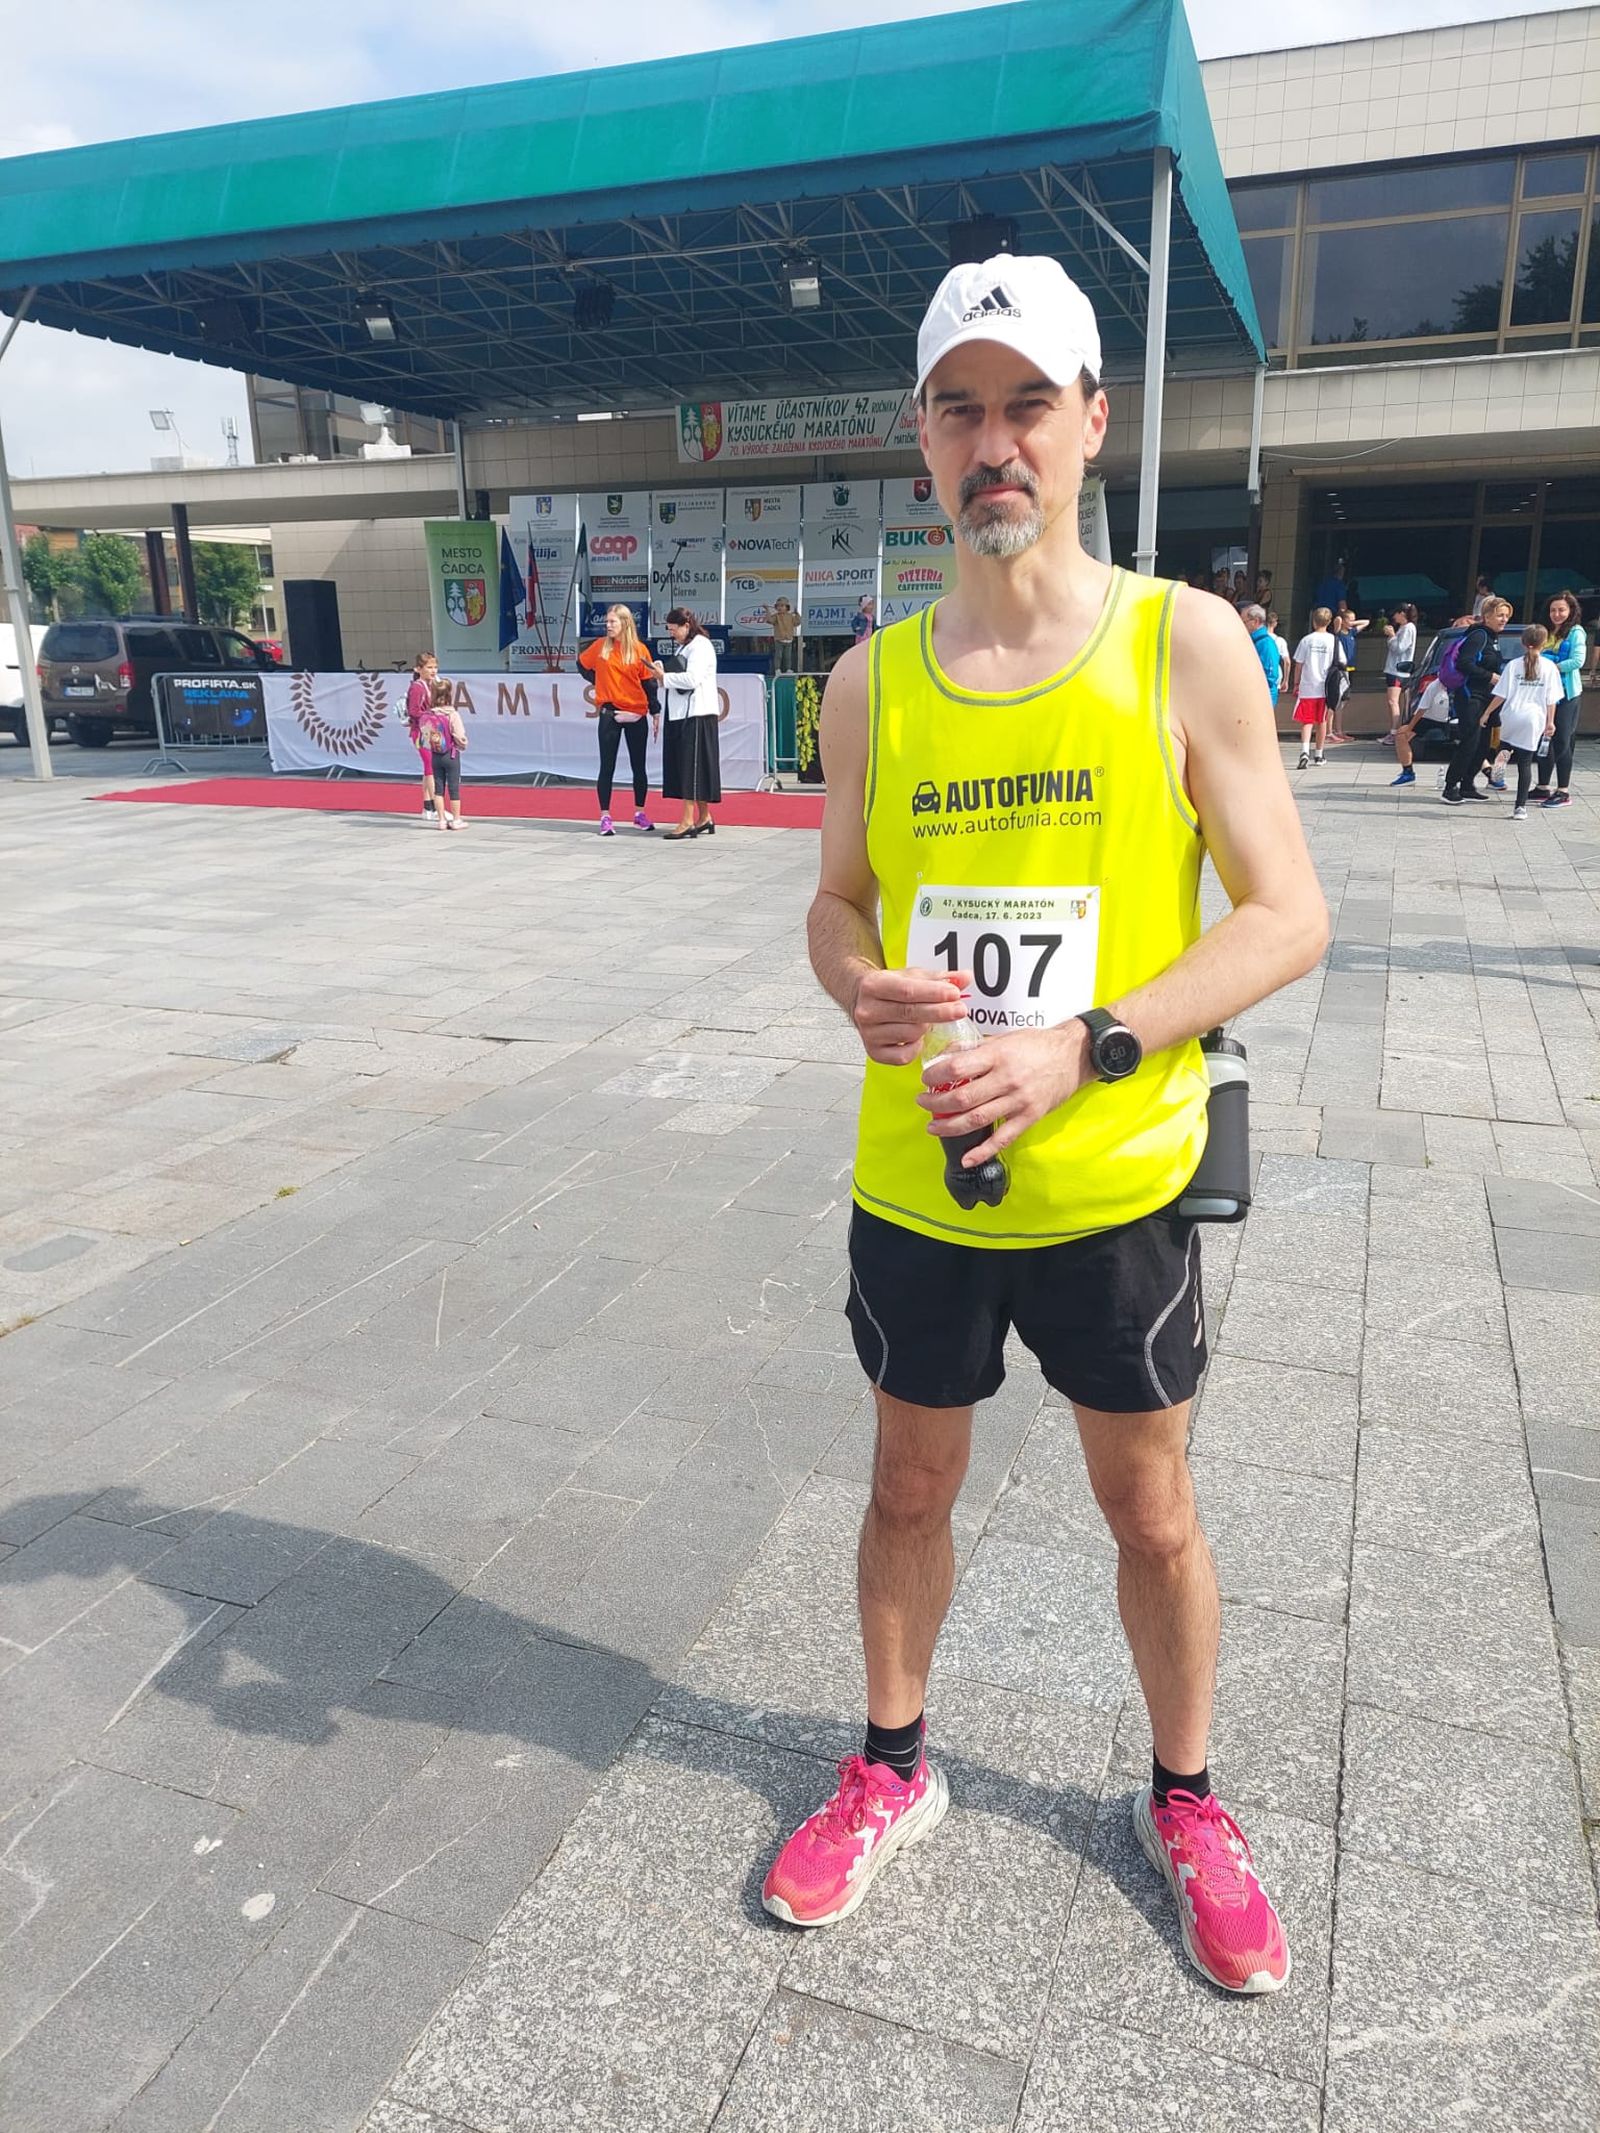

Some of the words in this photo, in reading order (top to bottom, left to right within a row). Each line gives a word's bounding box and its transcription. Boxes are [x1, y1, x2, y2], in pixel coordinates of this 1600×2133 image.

[962, 307, 1022, 323] adidas
[727, 403, 767, 423] VÍTAME
[776, 397, 850, 420] ÚČASTNÍKOV
[855, 397, 870, 415] 47.
[727, 421, 796, 443] KYSUCKÉHO
[804, 415, 876, 438] MARATÓNU
[848, 434, 883, 449] MARATÓNU
[441, 548, 482, 559] MESTO
[590, 535, 638, 562] coop
[441, 561, 485, 575] ČADCA
[805, 570, 835, 581] NIKA
[836, 568, 876, 581] SPORT
[694, 572, 719, 583] s.r.o.
[897, 568, 943, 584] PIZZERIA
[735, 580, 756, 591] TCB
[808, 607, 847, 620] PAJMI
[183, 688, 249, 699] REKLAMA
[912, 809, 1102, 839] www.autofunia.com
[942, 898, 955, 908] 47.
[957, 898, 1001, 909] KYSUCKÝ
[1004, 898, 1055, 909] MARATÓN
[951, 910, 983, 920] Čadca,
[985, 911, 1000, 920] 17.
[1016, 911, 1042, 920] 2023
[933, 930, 1063, 998] 107
